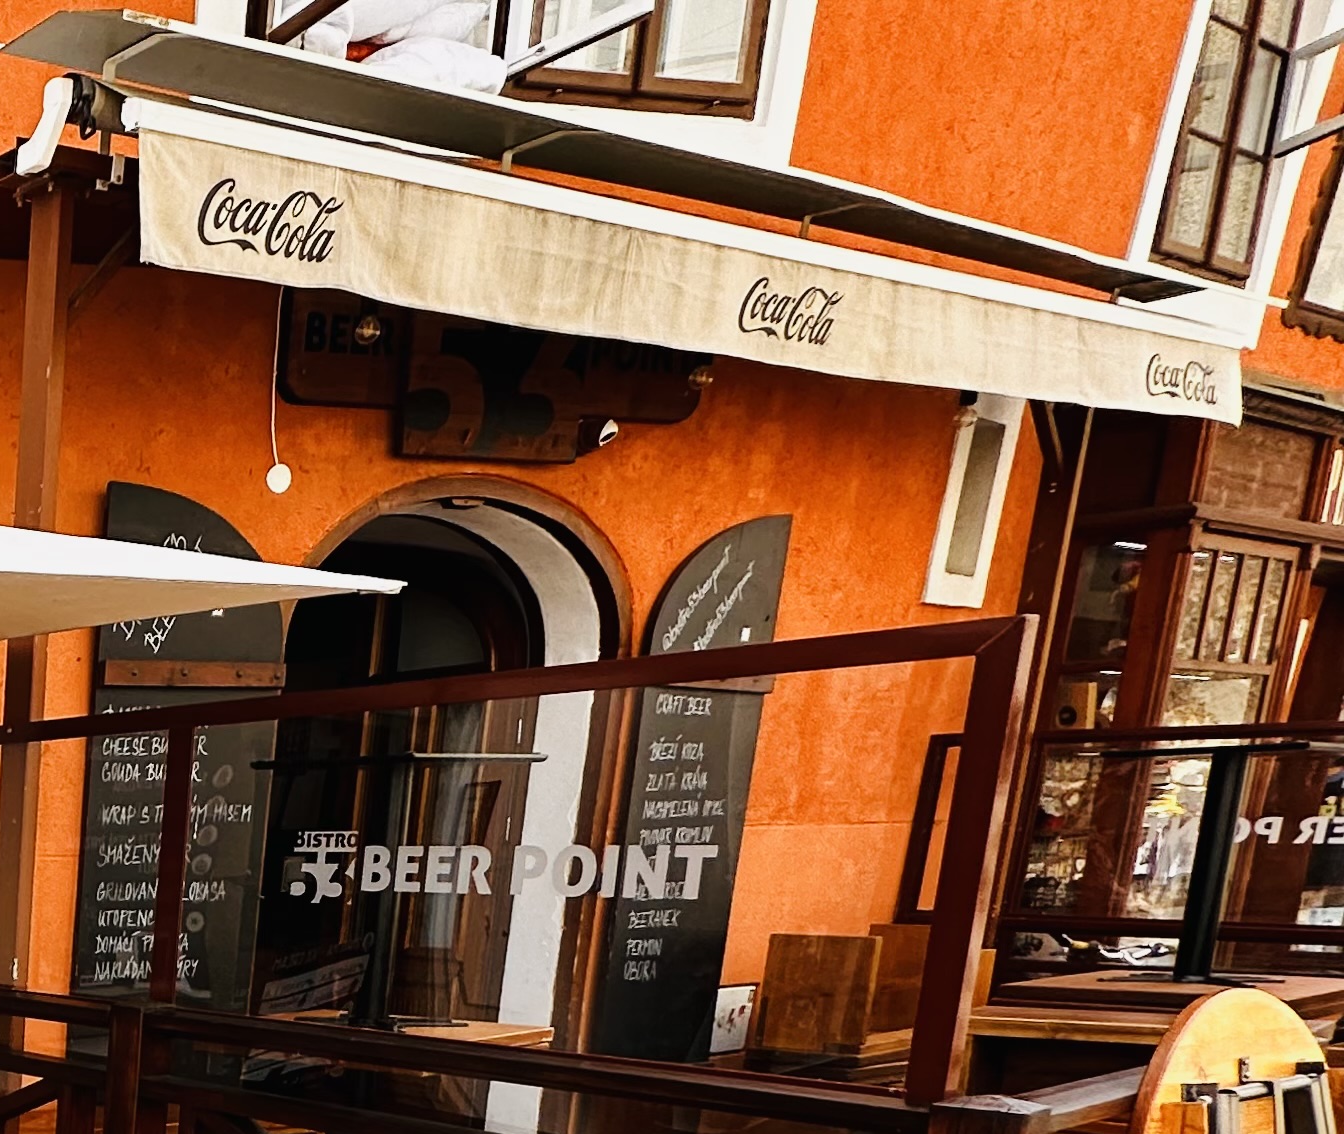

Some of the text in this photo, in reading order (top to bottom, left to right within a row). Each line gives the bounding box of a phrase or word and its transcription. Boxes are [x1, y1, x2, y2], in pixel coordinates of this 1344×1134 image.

[197, 177, 345, 264] Coca-Cola
[737, 276, 845, 347] Coca-Cola
[1145, 352, 1218, 406] Coca-Cola
[144, 616, 177, 654] BEE
[684, 696, 712, 716] BEER
[102, 735, 209, 756] CHEESE BUR
[101, 761, 203, 783] GOUDA BUR
[101, 803, 137, 826] WRAP
[139, 804, 151, 825] S
[295, 831, 359, 849] BISTRO
[361, 843, 719, 900] BEER POINT
[96, 878, 159, 902] GRILOVAN
[97, 909, 155, 927] UTOPENC
[93, 956, 153, 982] NAKLÁDAN
